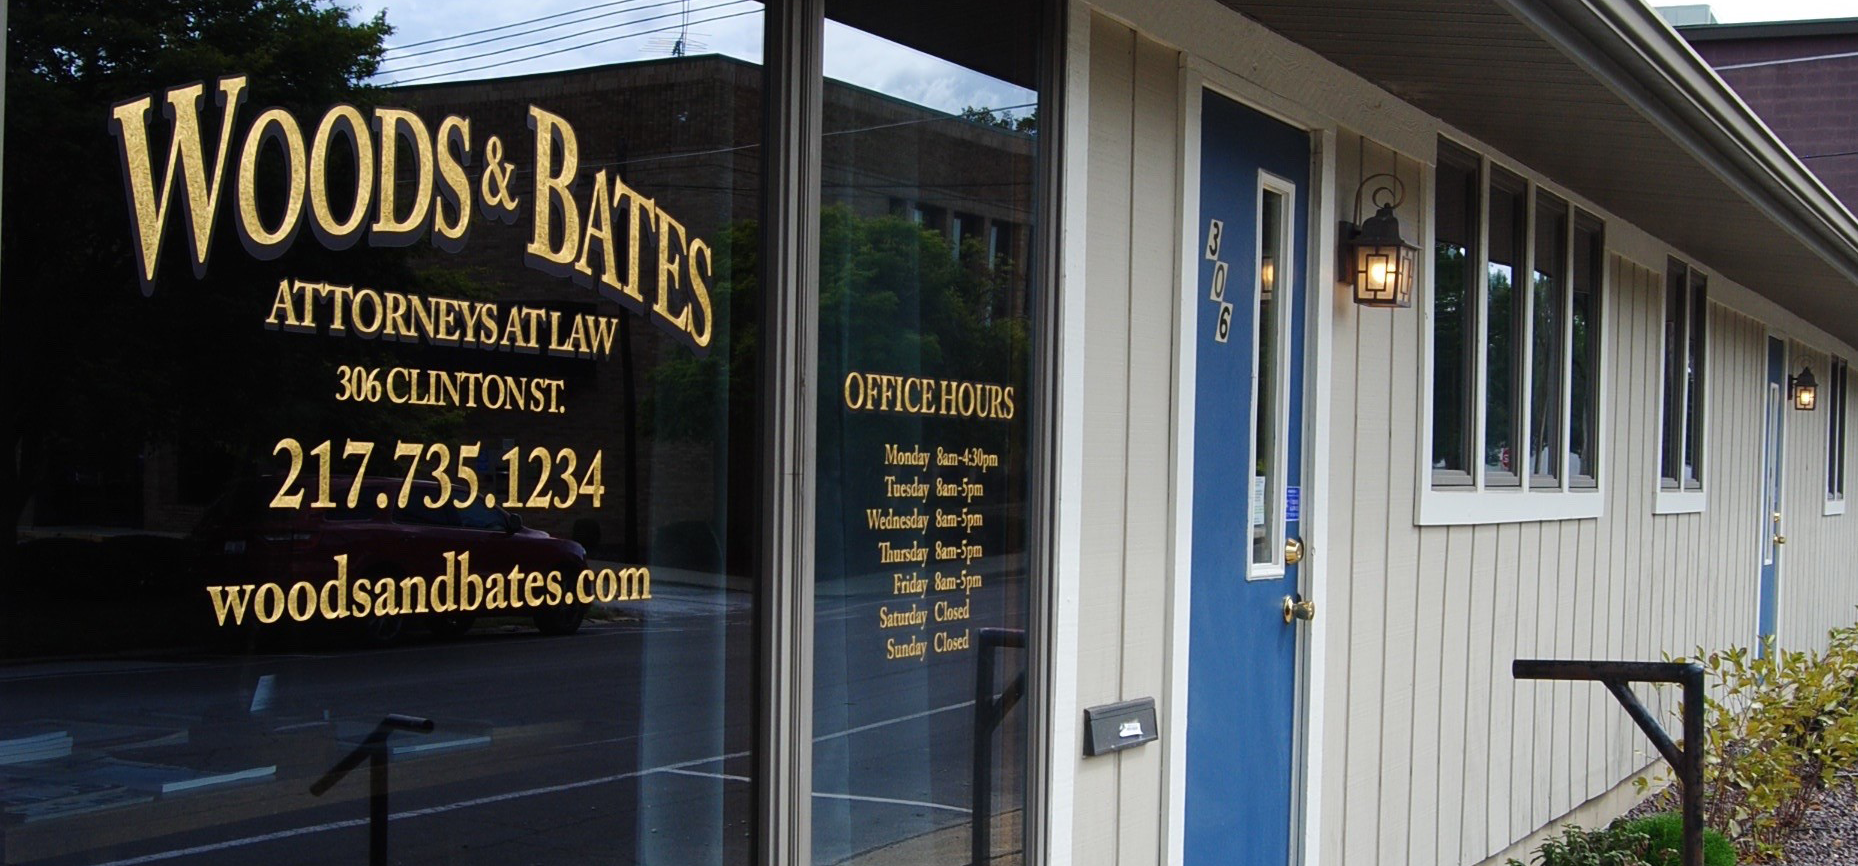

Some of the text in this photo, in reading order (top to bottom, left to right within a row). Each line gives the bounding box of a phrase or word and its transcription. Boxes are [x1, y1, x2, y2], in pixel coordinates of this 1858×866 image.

[112, 75, 713, 348] WOODS & BATES
[265, 278, 619, 356] ATTORNEYS AT LAW
[335, 365, 566, 414] 306 CLINTON ST.
[844, 371, 1014, 420] OFFICE HOURS
[269, 437, 606, 510] 217.735.1234
[884, 443, 999, 472] Monday 8am-4:30pm
[884, 475, 984, 504] Tuesday 8am-5pm
[866, 507, 984, 534] Wednesday 8am-5pm
[878, 539, 983, 567] Thursday 8am-5pm
[206, 550, 652, 627] woodsandbates.com
[893, 569, 982, 598] Friday 8am-5pm
[879, 598, 970, 631] Saturday Closed
[886, 629, 970, 662] Sunday Closed
